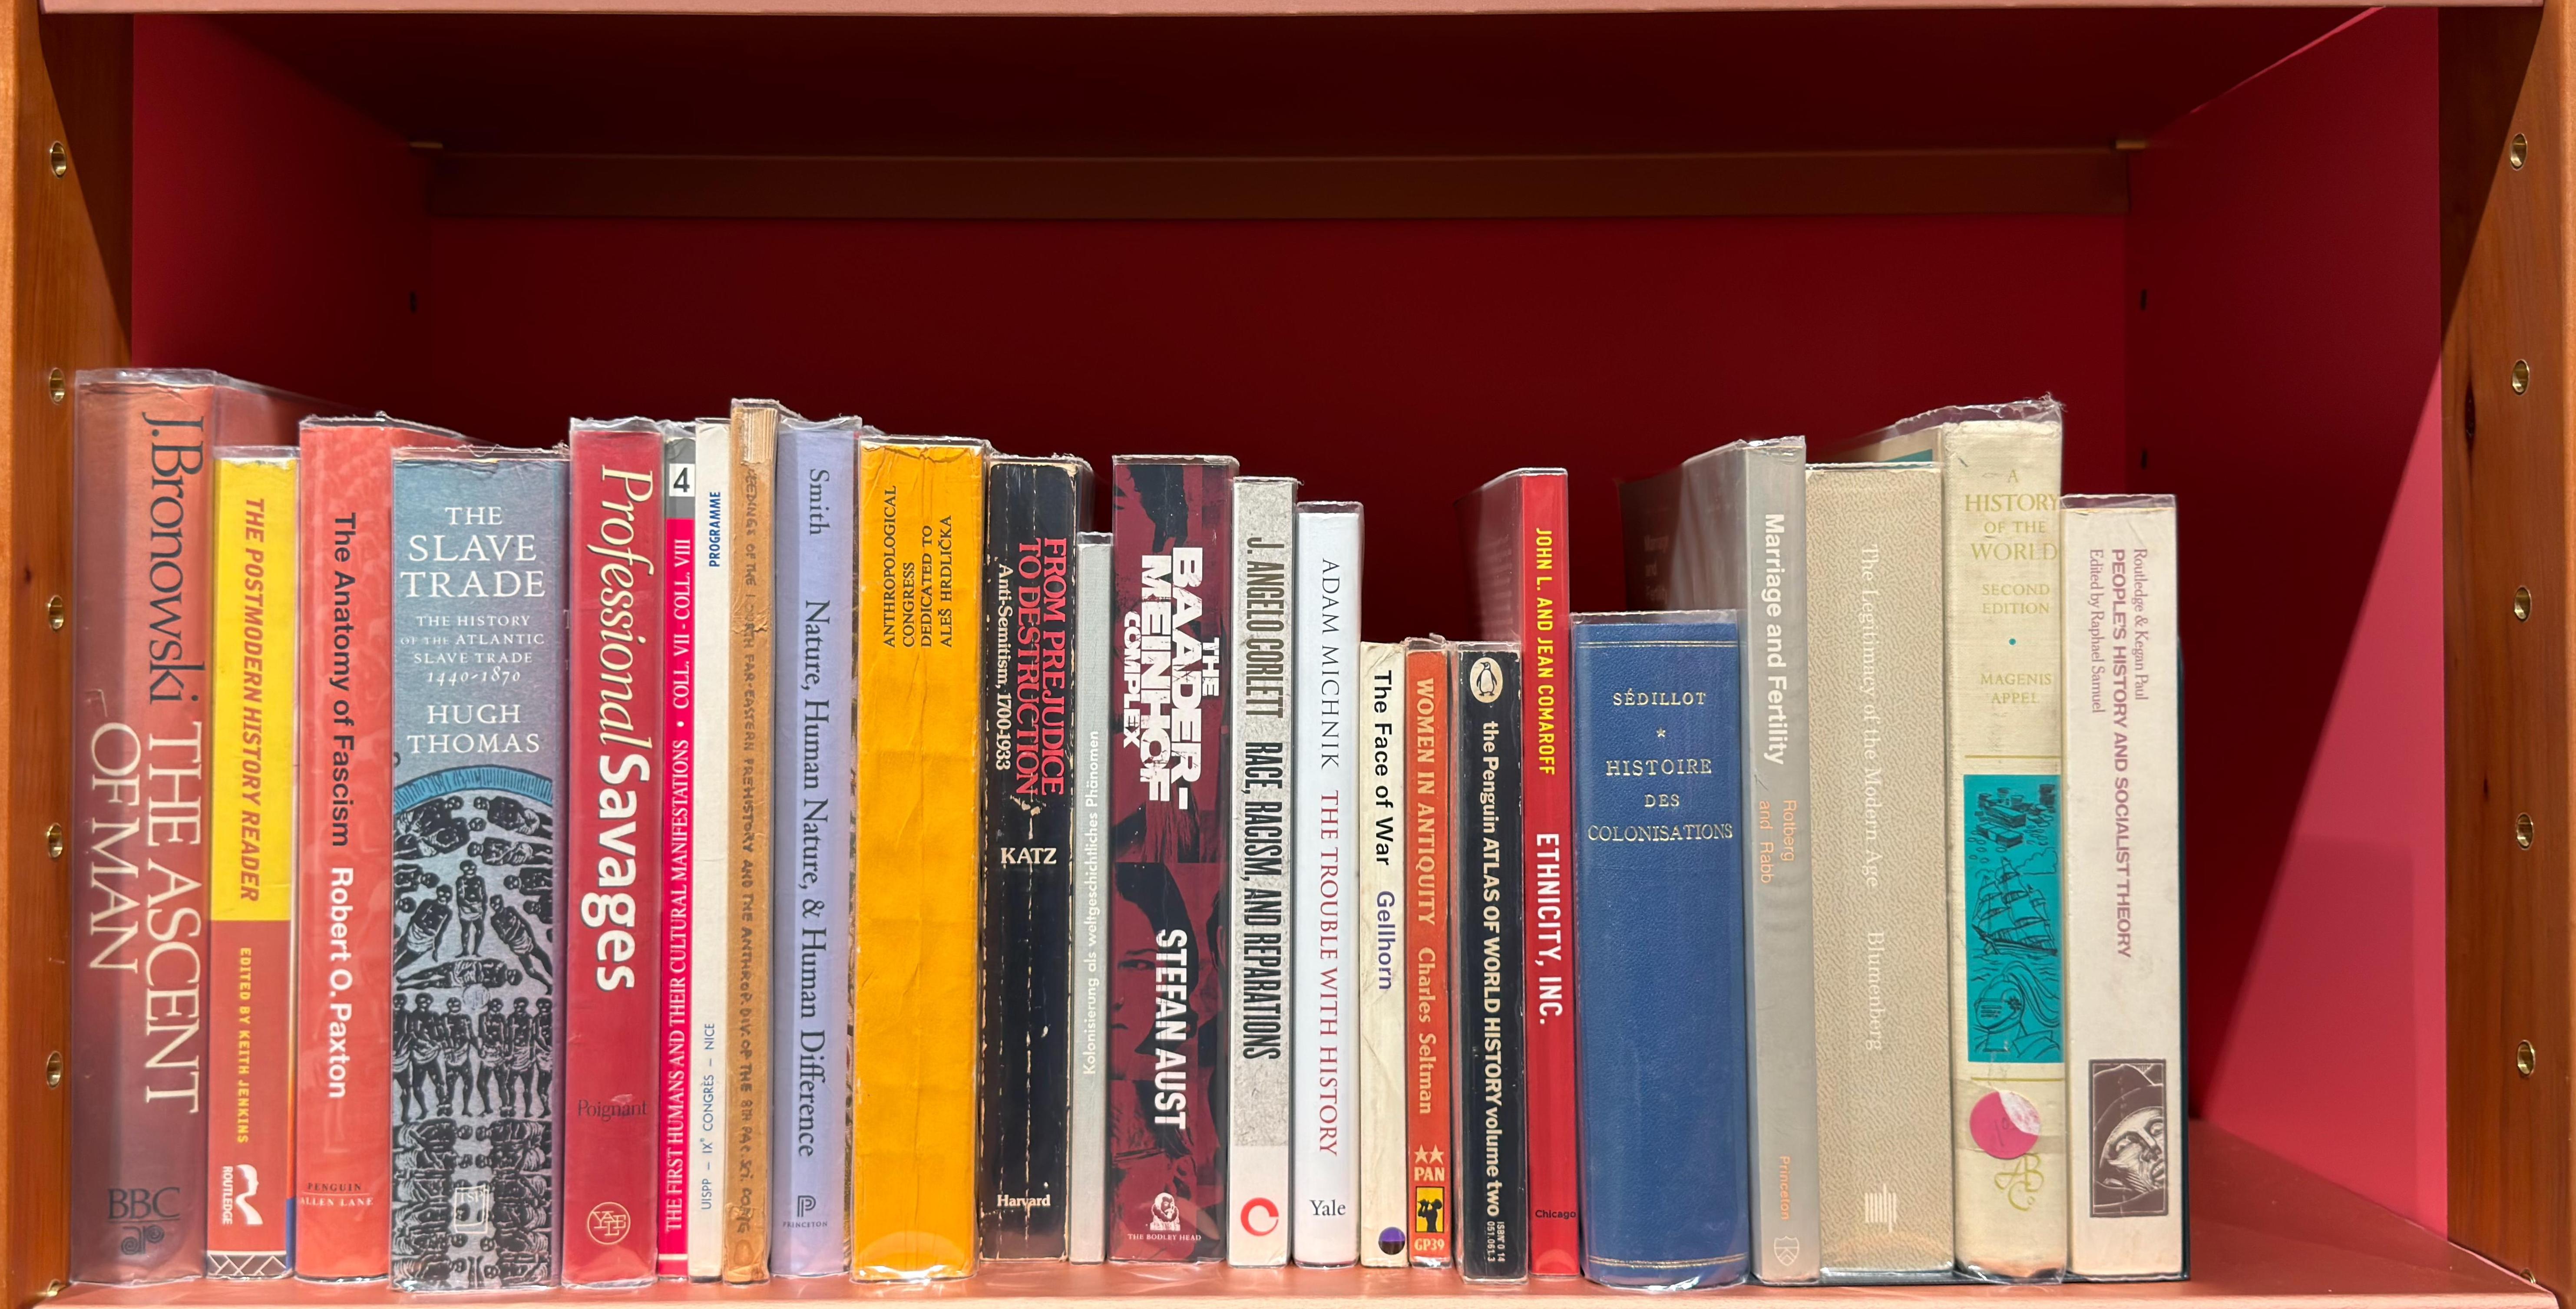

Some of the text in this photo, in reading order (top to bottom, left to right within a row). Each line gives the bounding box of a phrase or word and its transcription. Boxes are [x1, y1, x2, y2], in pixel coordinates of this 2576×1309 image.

[709, 491, 721, 567] PROGRAMME
[810, 468, 830, 535] Smith
[1965, 494, 2059, 512] HISTORY
[400, 571, 546, 597] TRADE
[409, 535, 537, 561] SLAVE
[674, 539, 690, 567] VIII
[883, 485, 896, 648] ANTHROPOLOGICAL
[938, 515, 952, 648] ALEŠ HRDLIČKA
[1970, 543, 2058, 561] WORLD
[457, 616, 531, 626] HISTORY
[673, 573, 690, 620] COLL.
[903, 562, 914, 648] CONGRESS
[920, 553, 933, 648] DEDICATED
[1982, 584, 2050, 595] SECOND
[1982, 603, 2050, 614] EDITION
[2132, 549, 2149, 700] Routledge Kegan Paul
[414, 652, 532, 663] SLAVE TRADE
[456, 634, 545, 645] ATLANTIC
[674, 633, 689, 657] VII
[995, 564, 1014, 770] Anti-Semitism, 1700-1933
[1042, 538, 1067, 795] FROM PREJUDICE
[1246, 561, 1284, 718] ANGELO CORLETT
[1321, 558, 1340, 769] ADAM MICHNIK
[1537, 528, 1555, 775] JOHN L. AND JEAN COMAROFF
[1762, 514, 1788, 765] Marriage and Fertility
[2087, 549, 2106, 713] Edited by Raphael Samuel
[329, 570, 355, 846] Anatomy Fascism
[427, 666, 520, 686] 1440-1870
[427, 705, 520, 723] HUGH
[673, 660, 688, 709] COLL.
[1016, 587, 1042, 795] DESTRUCTION
[1124, 611, 1140, 748] COMPLEX
[1140, 555, 1172, 802] MEINHOF
[1171, 547, 1203, 810] BAADER-
[1613, 689, 1705, 706] SÉDILLOT
[1981, 673, 2051, 685] MAGENIS
[1991, 693, 2039, 704] APPEL
[240, 548, 264, 901] POSTMODERN HISTORY READER
[407, 734, 540, 753] THOMAS
[580, 465, 654, 992] Professional Savages
[1858, 590, 1883, 887] Legitimacy Modern Age
[2112, 549, 2131, 958] PEOPLE'S HISTORY AND SOCIALIST THEORY
[742, 758, 755, 852] PREHISTORY
[1375, 723, 1394, 866] Face War
[1416, 678, 1435, 925] WOMEN IN ANTIQUITY
[1606, 759, 1712, 776] HISTOIRE
[1645, 794, 1680, 807] DES
[671, 740, 688, 881] MANIFESTATIONS
[1588, 823, 1733, 841] COLONISATIONS
[1759, 800, 1774, 884] and Rabb
[1781, 799, 1797, 861] Rotberg
[798, 600, 830, 1157] Nature, Human Nature, Human Difference
[1001, 848, 1057, 864] KATZ
[89, 818, 140, 973] MAN
[145, 721, 202, 1113] THE ASCENT
[670, 884, 686, 973] CULTURAL
[1083, 731, 1100, 1075] Kolonisierung weltgeschichtliches Phänomen
[1241, 742, 1283, 1060] RACE, RACISM, REPARATIONS
[1535, 834, 1562, 1025] ETHNICITY, INC.
[1377, 890, 1396, 989] Gellhorn
[1480, 721, 1503, 1217] the Penguin ATLAS OF WORLD HISTORY volume two
[328, 867, 354, 1098] Robert Paxton
[669, 973, 686, 1027] THEIR
[1319, 847, 1339, 1157] TROUBLE WITH HISTORY
[1867, 933, 1885, 1051] Blumenberg
[237, 948, 251, 1143] EDITED KEITH JENKINS
[704, 1024, 714, 1050] NICE
[1154, 929, 1187, 1129] STEFAN AUST
[1418, 947, 1436, 1114] Charles Seltman
[578, 1099, 647, 1121] Poignant
[668, 1071, 684, 1146] HUMANS
[108, 1187, 180, 1220] BBC
[222, 1166, 232, 1225] ROUTLEDGE
[308, 1183, 361, 1191] PENGUIN
[341, 1197, 374, 1207] LANE
[667, 1151, 684, 1196] FIRST
[701, 1178, 711, 1210] UISPP
[997, 1195, 1050, 1207] Harvard
[1309, 1200, 1346, 1216] Yale
[1414, 1166, 1445, 1182] PAN
[1779, 1156, 1790, 1220] Princeton
[1414, 1238, 1445, 1251] GP39
[1535, 1210, 1576, 1220] Chicago
